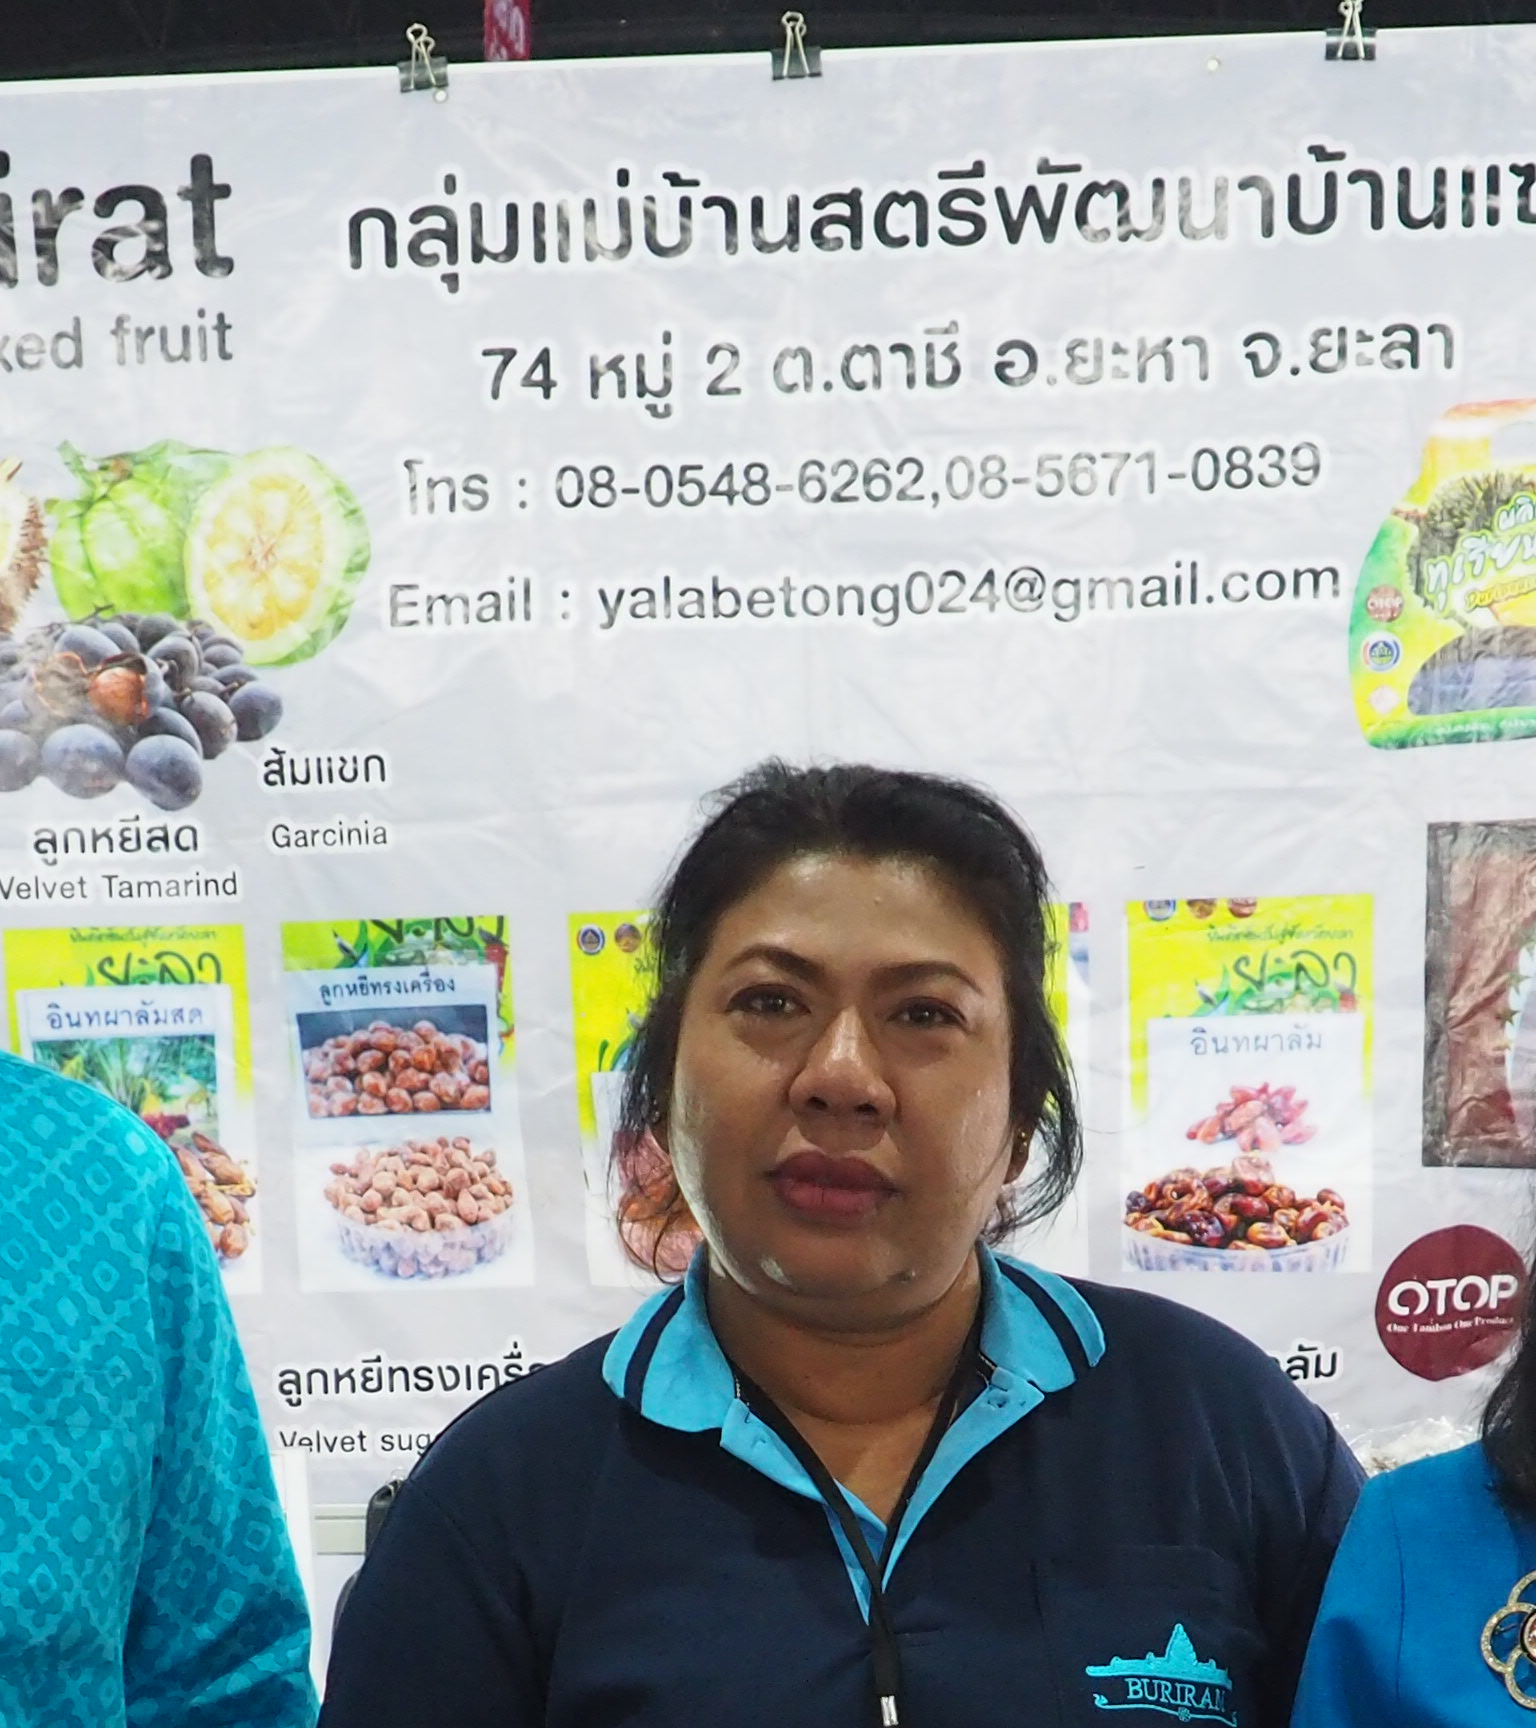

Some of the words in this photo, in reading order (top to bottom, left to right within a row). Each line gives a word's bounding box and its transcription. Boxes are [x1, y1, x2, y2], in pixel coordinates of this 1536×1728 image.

[111, 308, 234, 364] fruit
[480, 346, 558, 400] 74
[588, 330, 673, 419] หมู่
[705, 343, 742, 396] 2
[772, 321, 963, 393] ต.ตาชี
[994, 334, 1211, 388] อ.ยะหา
[1243, 320, 1457, 378] จ.ยะลา
[388, 577, 533, 628] Email
[598, 560, 1340, 629] yalabetong024@gmail.com
[262, 746, 388, 789] ส้มแขก
[31, 813, 200, 867] ลูกหยีสด
[270, 820, 388, 851] Garcinia
[101, 872, 239, 899] Tamarind
[1387, 1273, 1519, 1317] OTOP
[278, 1341, 548, 1407] ลูกหยีทรงเครื่
[1272, 1343, 1338, 1381] ลัม
[279, 1430, 368, 1453] Velvet
[380, 1432, 440, 1457] sug
